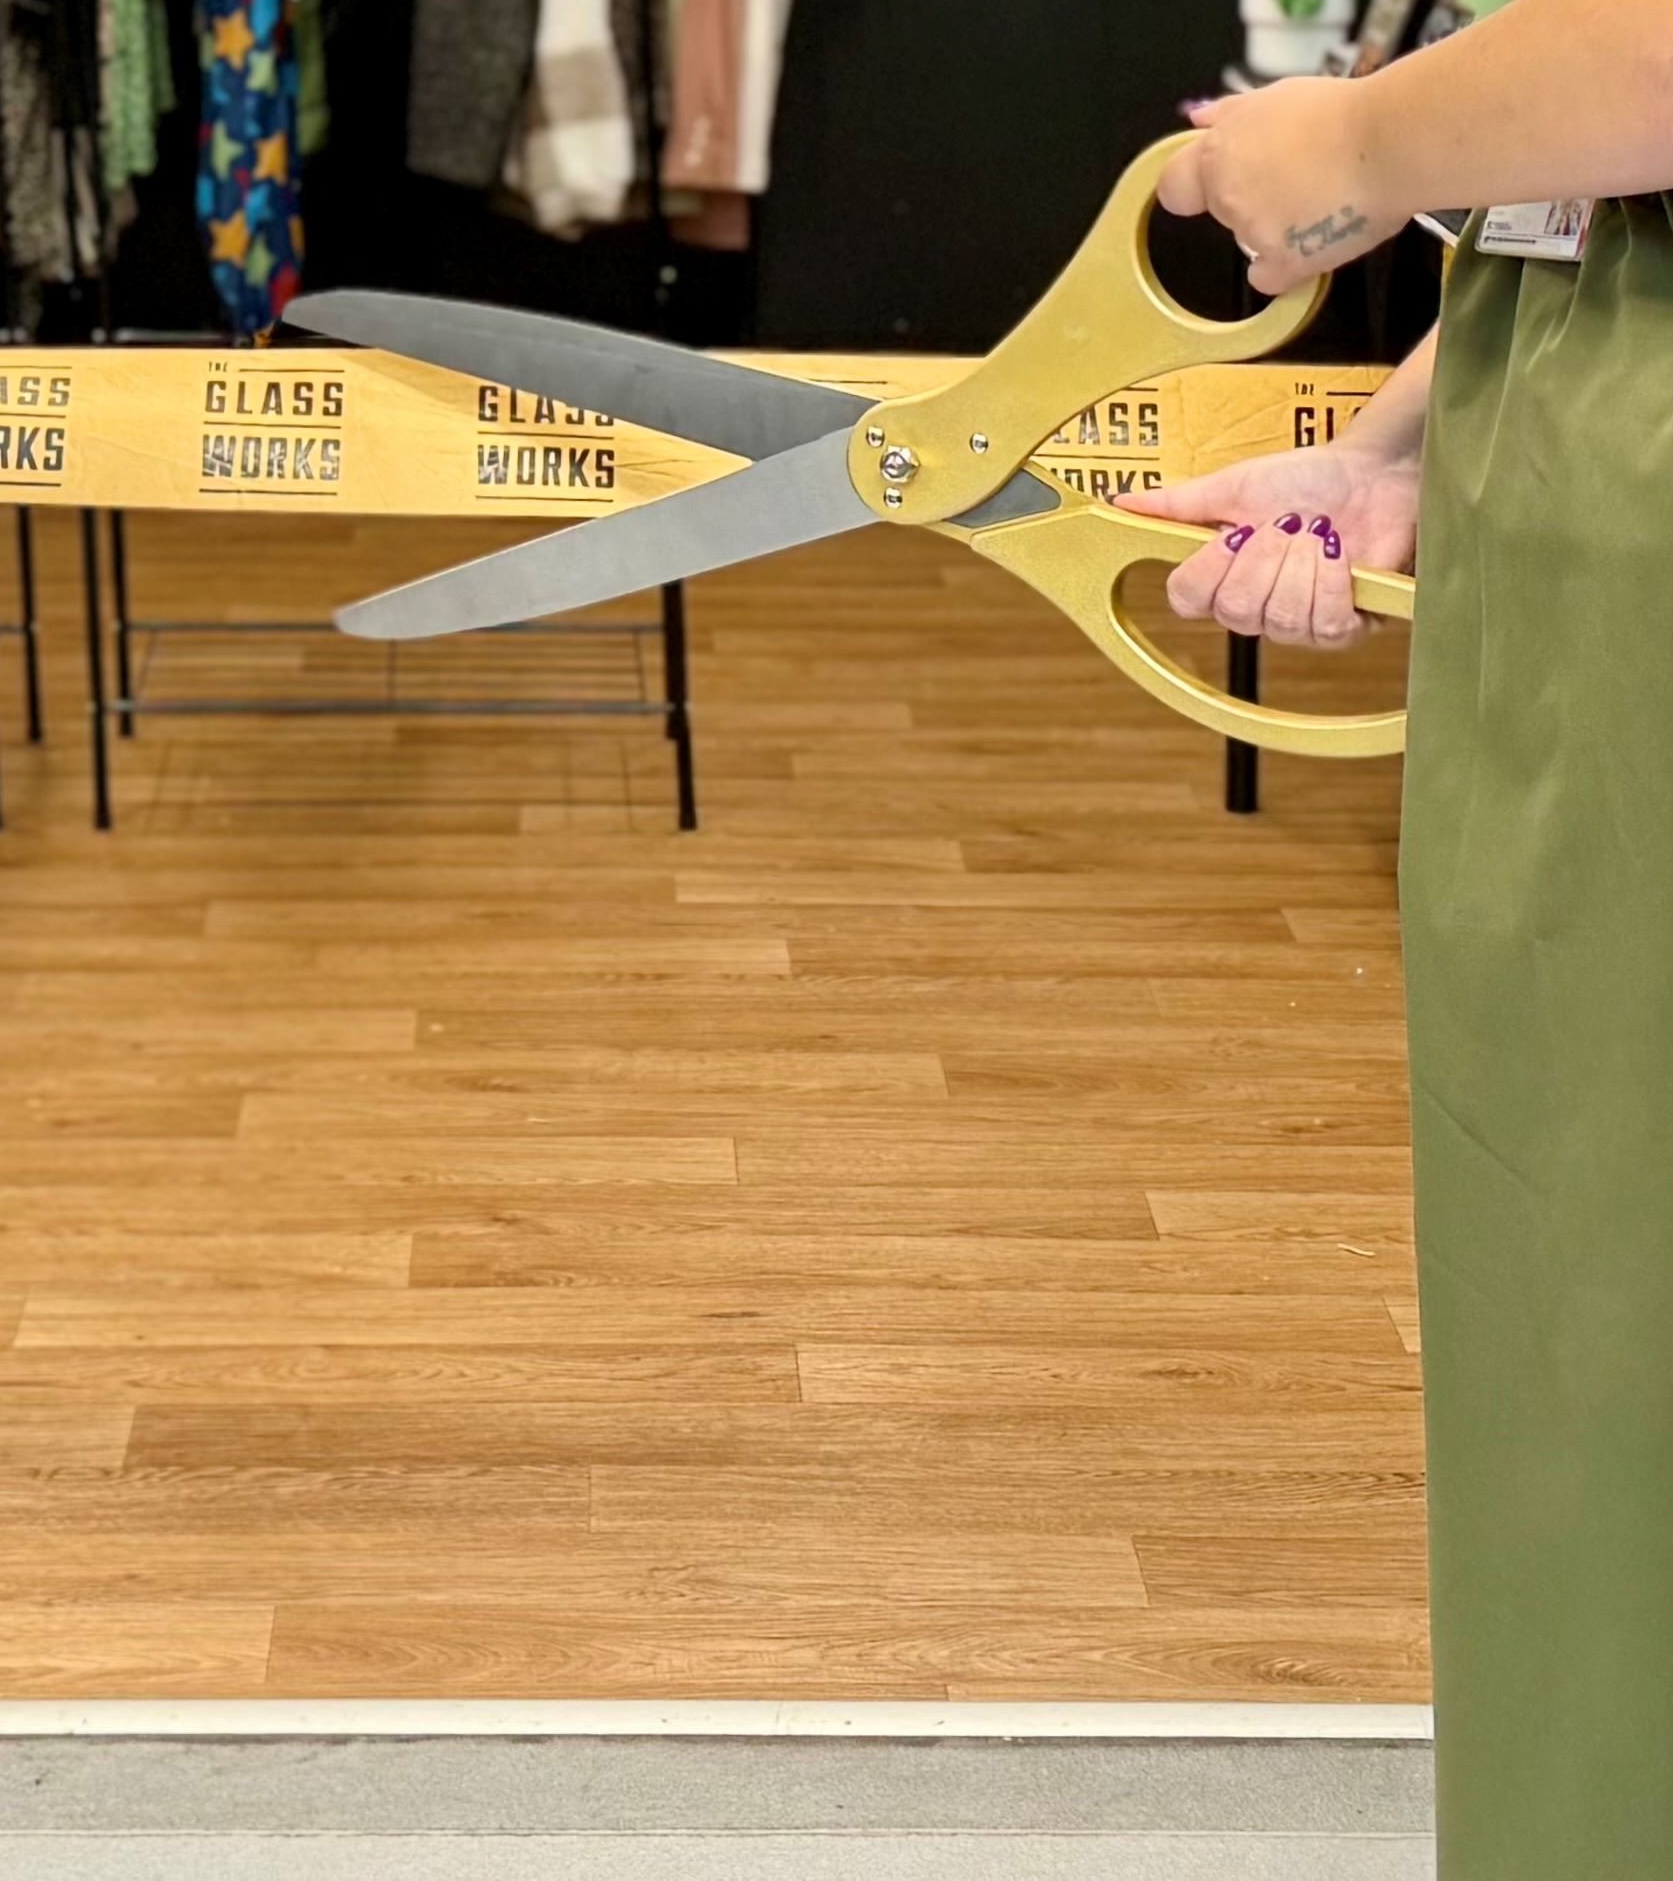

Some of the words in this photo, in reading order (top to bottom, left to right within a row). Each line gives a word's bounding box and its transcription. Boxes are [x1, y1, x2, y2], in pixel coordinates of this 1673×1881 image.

[205, 380, 344, 417] GLASS
[479, 385, 614, 427] GLA
[1054, 402, 1159, 446] ASS
[202, 434, 341, 481] WORKS
[478, 444, 615, 489] WORKS
